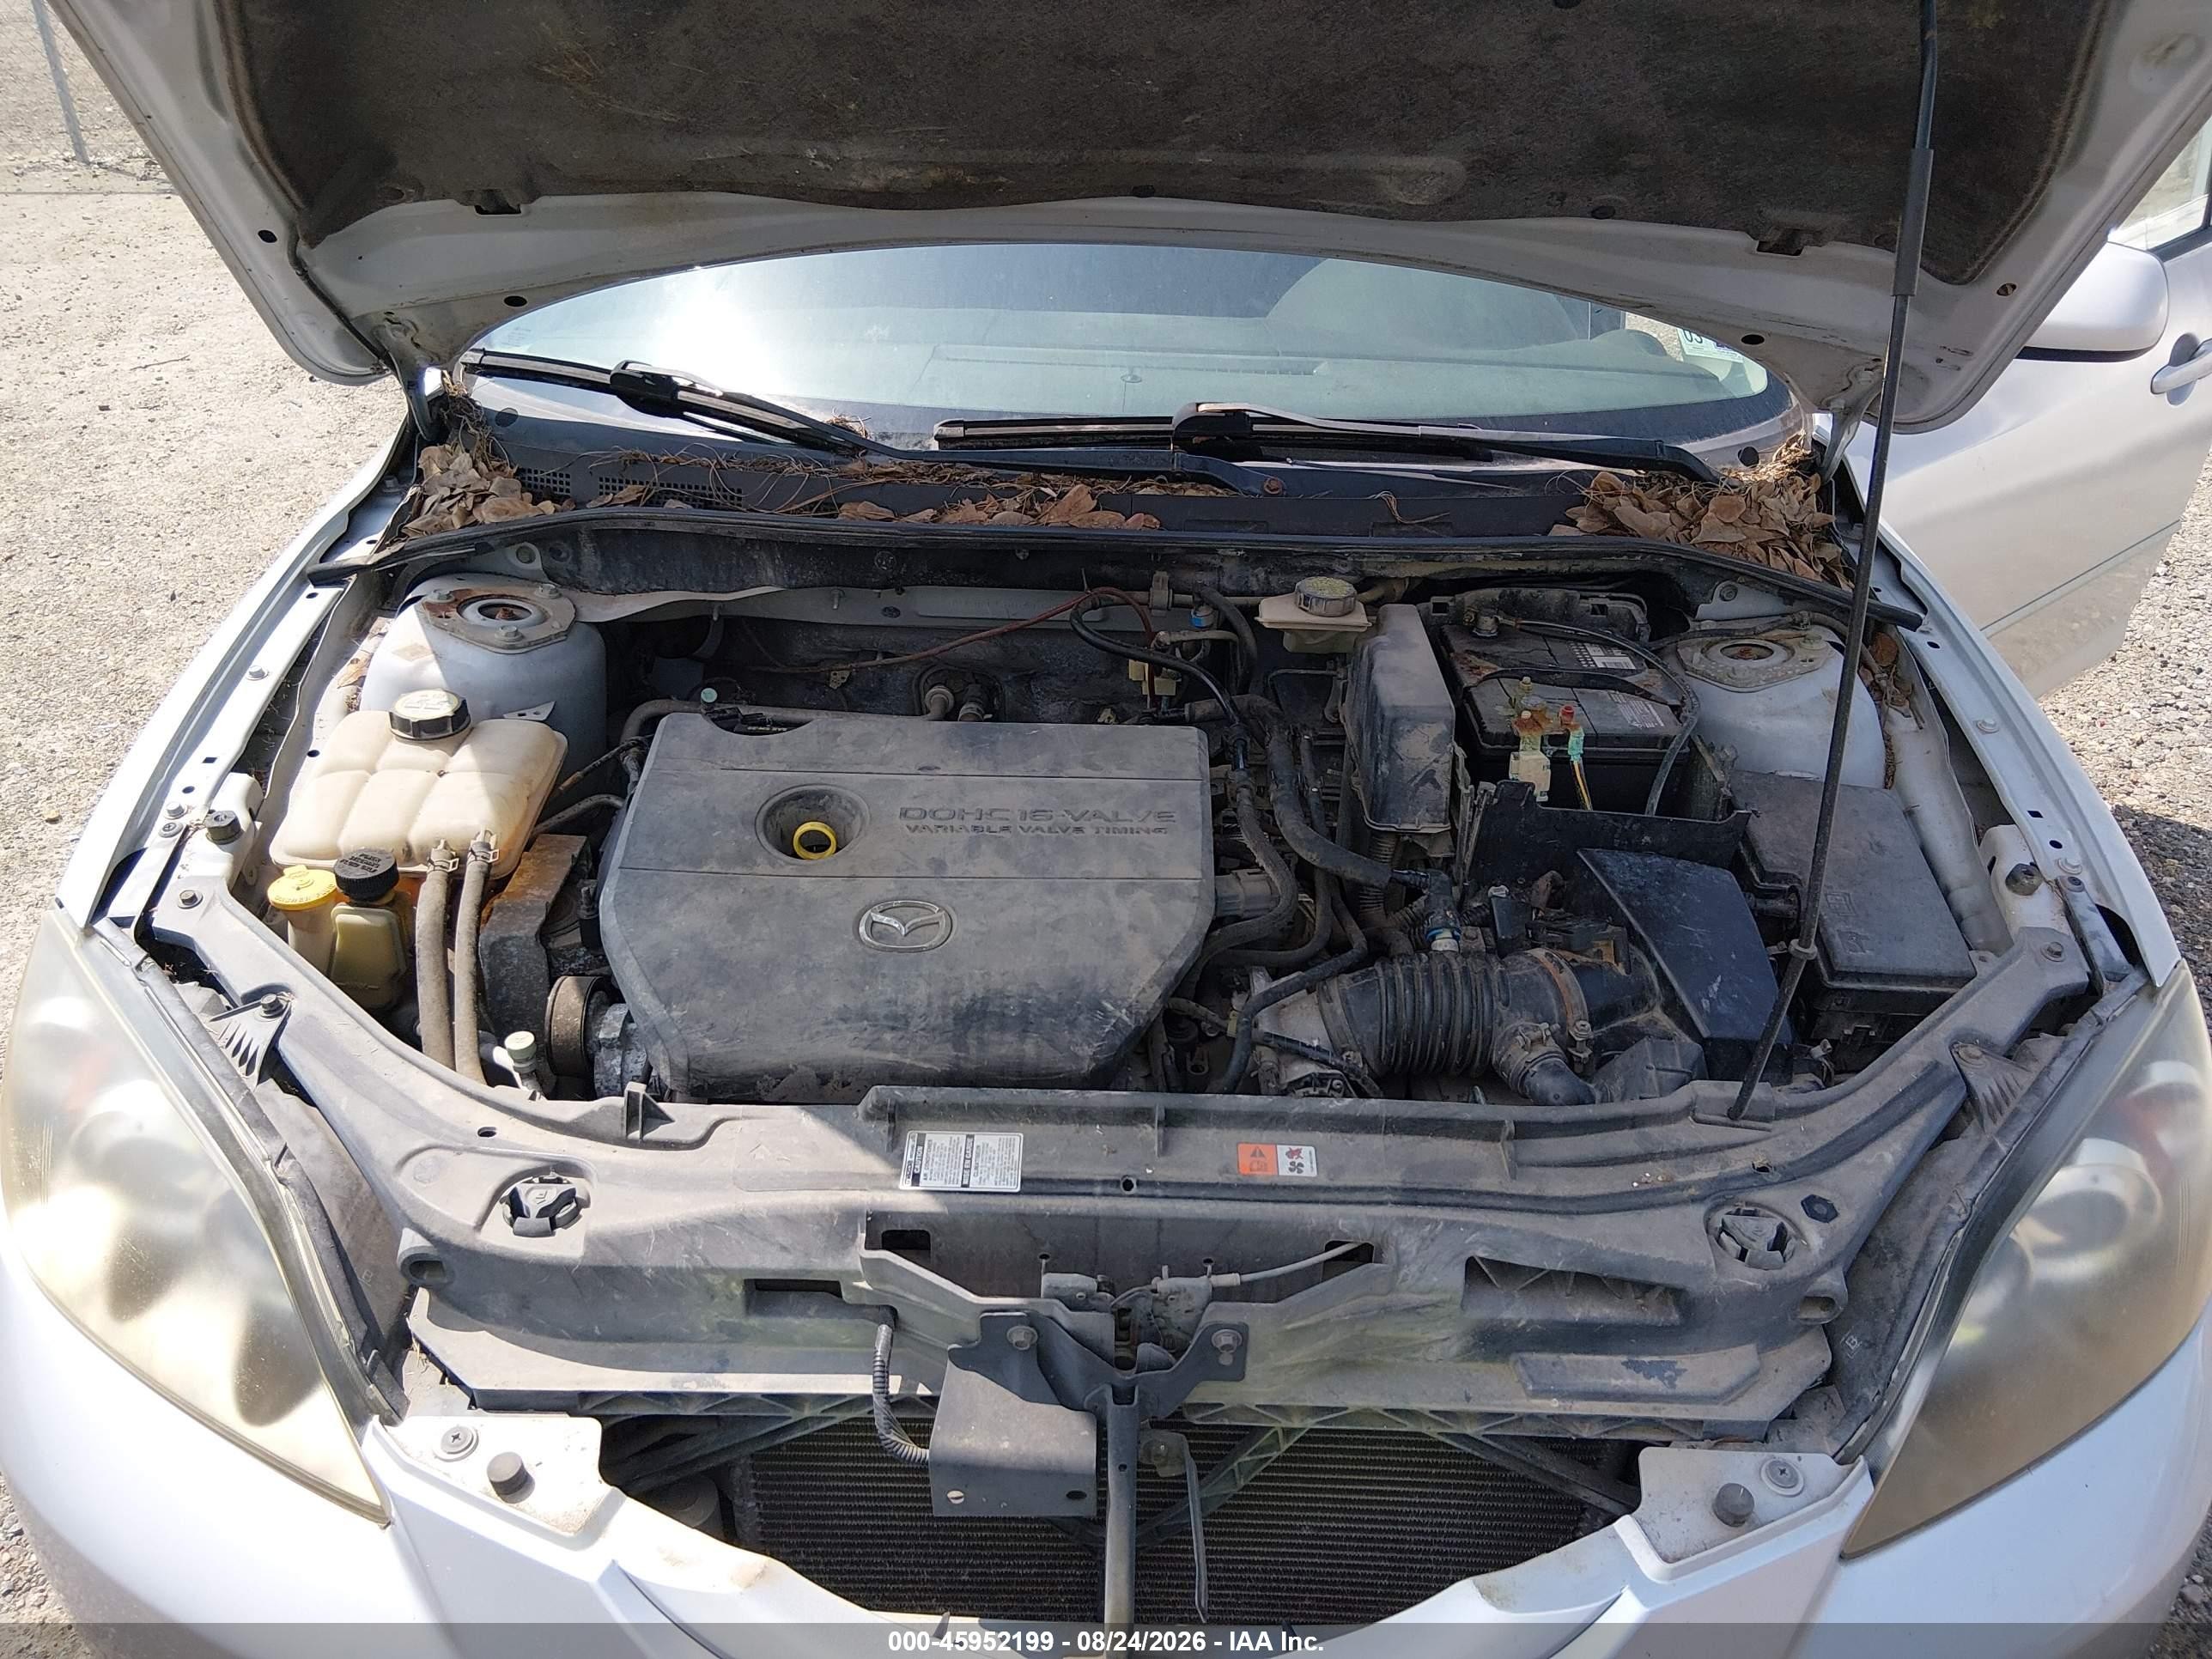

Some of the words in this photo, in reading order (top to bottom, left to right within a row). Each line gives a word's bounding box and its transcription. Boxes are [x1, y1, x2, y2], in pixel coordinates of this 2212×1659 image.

[899, 807, 1011, 822] DOHC
[1018, 808, 1176, 823] 16-VALVE
[905, 824, 1012, 834] VARIABLE
[1018, 825, 1086, 835] VALVE
[1094, 826, 1169, 836] TIMING
[914, 1146, 923, 1174] CAUTION
